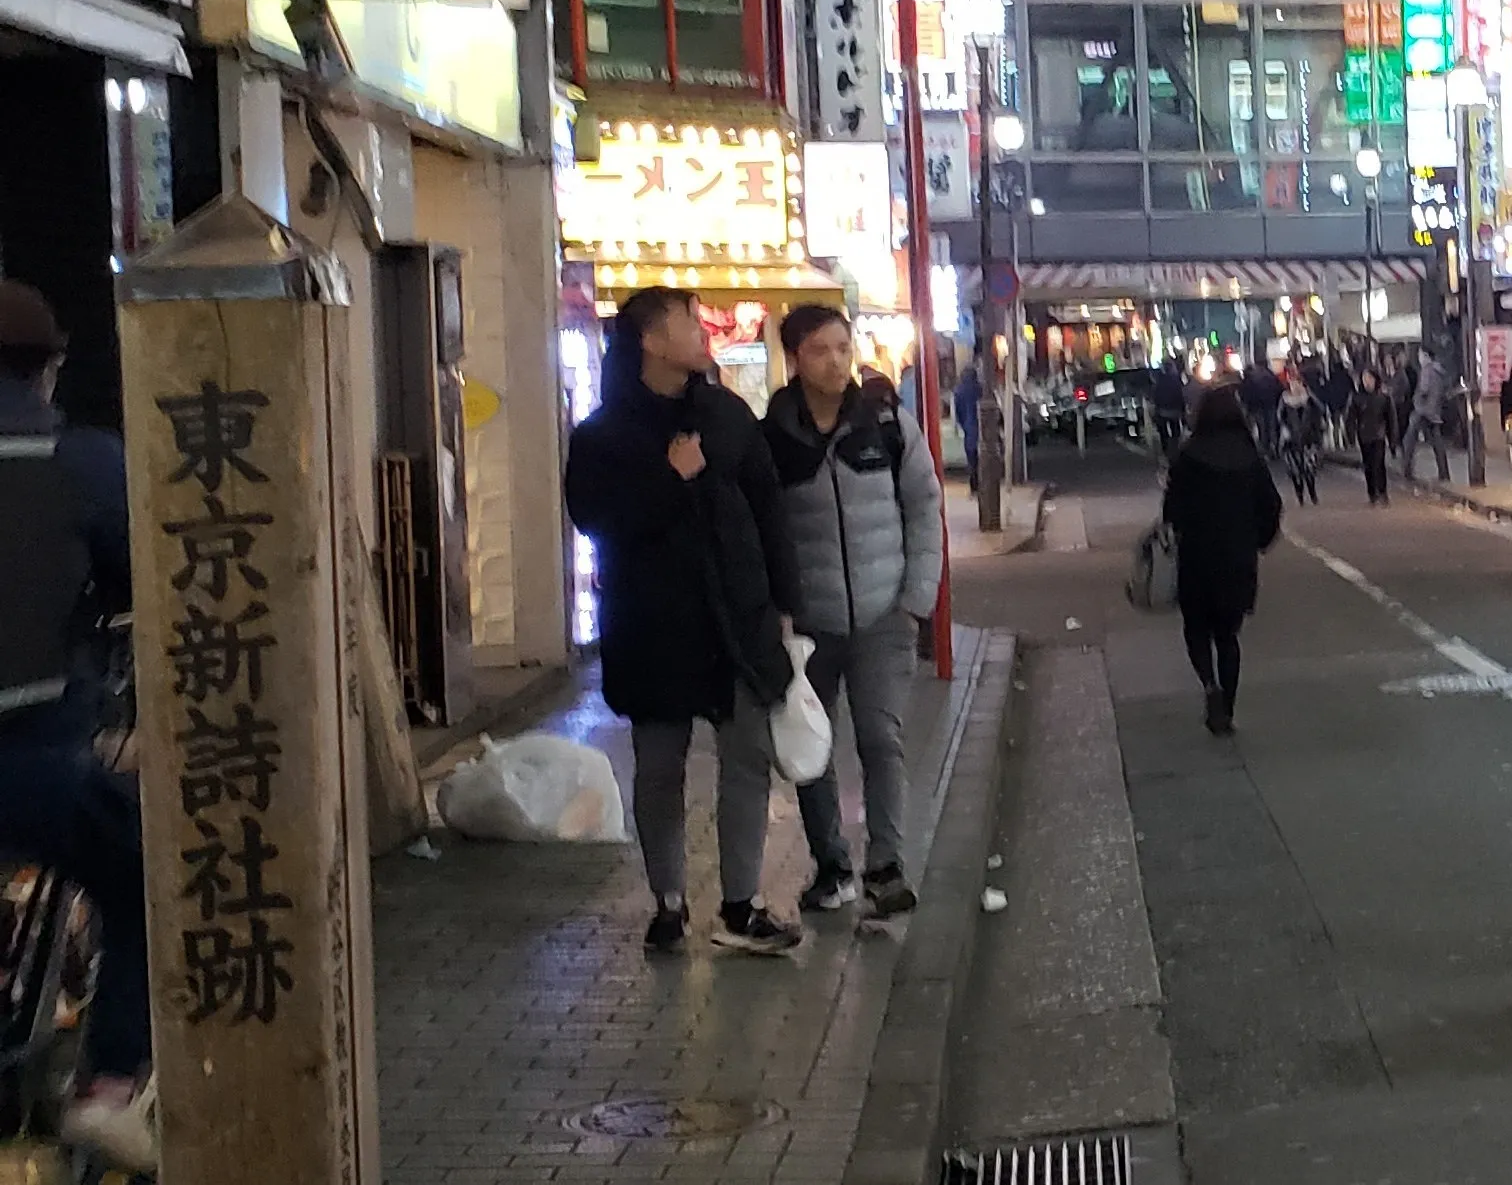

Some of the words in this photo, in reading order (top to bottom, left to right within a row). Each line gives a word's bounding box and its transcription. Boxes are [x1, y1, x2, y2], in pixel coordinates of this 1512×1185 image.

[583, 155, 778, 208] ーメン王
[155, 378, 294, 1027] 東京新詩社跡
